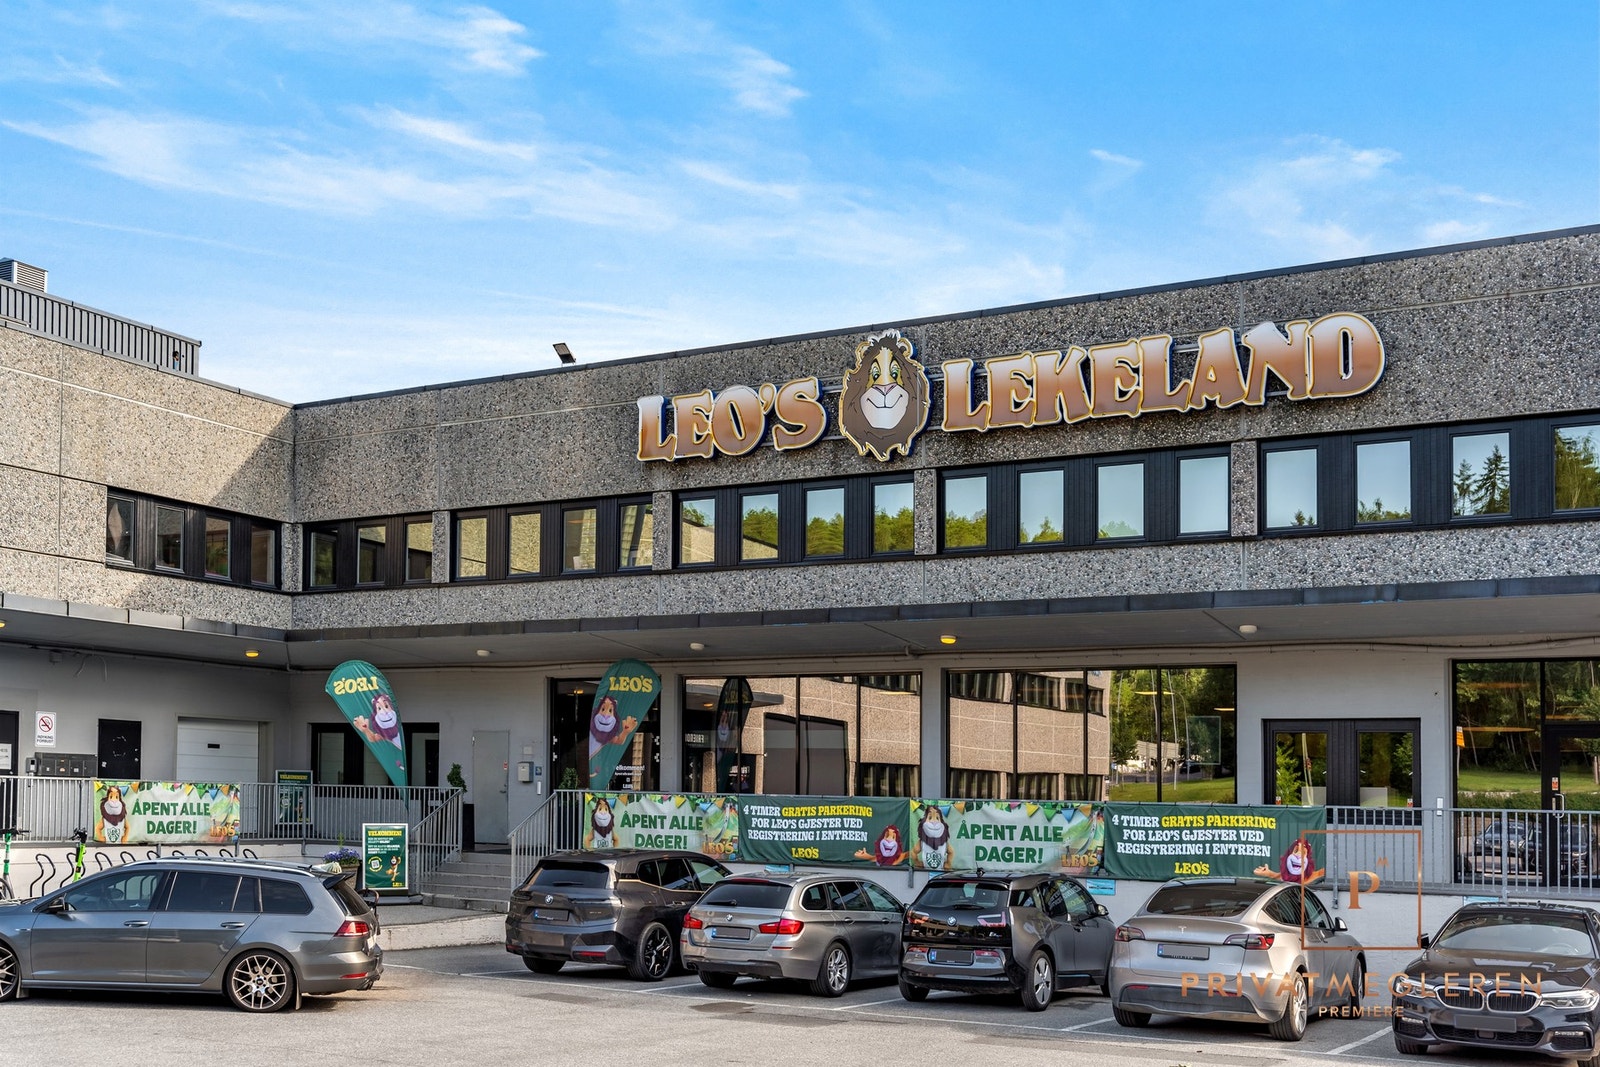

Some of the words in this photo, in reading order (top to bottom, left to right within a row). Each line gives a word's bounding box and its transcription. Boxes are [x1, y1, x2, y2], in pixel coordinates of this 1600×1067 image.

[637, 376, 827, 462] LEO'S
[941, 312, 1386, 433] LEKELAND
[609, 675, 653, 693] LEO'S
[131, 798, 178, 816] ÅPENT
[180, 802, 211, 816] ALLE
[743, 804, 750, 815] 4
[750, 805, 780, 817] TIMER
[782, 806, 816, 817] GRATIS
[818, 805, 873, 818] PARKERING
[146, 820, 197, 835] DAGER!
[620, 810, 667, 829] ÅPENT
[669, 815, 704, 831] ALLE
[751, 817, 770, 828] FOR
[771, 818, 797, 829] LEO'S
[798, 818, 842, 829] GJESTER
[843, 818, 863, 828] VED
[1111, 814, 1119, 826] 4
[1120, 815, 1160, 828] TIMER
[1161, 815, 1205, 828] GRATIS
[1206, 815, 1277, 829] PARKERING
[748, 829, 814, 841] REGISTRERING
[815, 831, 820, 841] I
[821, 830, 868, 842] ENTREEN
[956, 820, 1017, 841] ÅPENT
[1020, 825, 1064, 842] ALLE
[1123, 829, 1146, 841] FOR
[1147, 829, 1180, 842] LEO'S
[1181, 829, 1238, 842] GJESTER
[1239, 829, 1264, 842] VED
[634, 833, 688, 850] DAGER!
[791, 846, 819, 859] LEO'S
[975, 845, 1043, 864] DAGER!
[1116, 842, 1203, 855] REGISTRERING
[1205, 844, 1210, 855] I
[1210, 843, 1271, 857] ENTREEN
[1061, 852, 1099, 868] LEO'S
[1174, 861, 1210, 875] LEO'S
